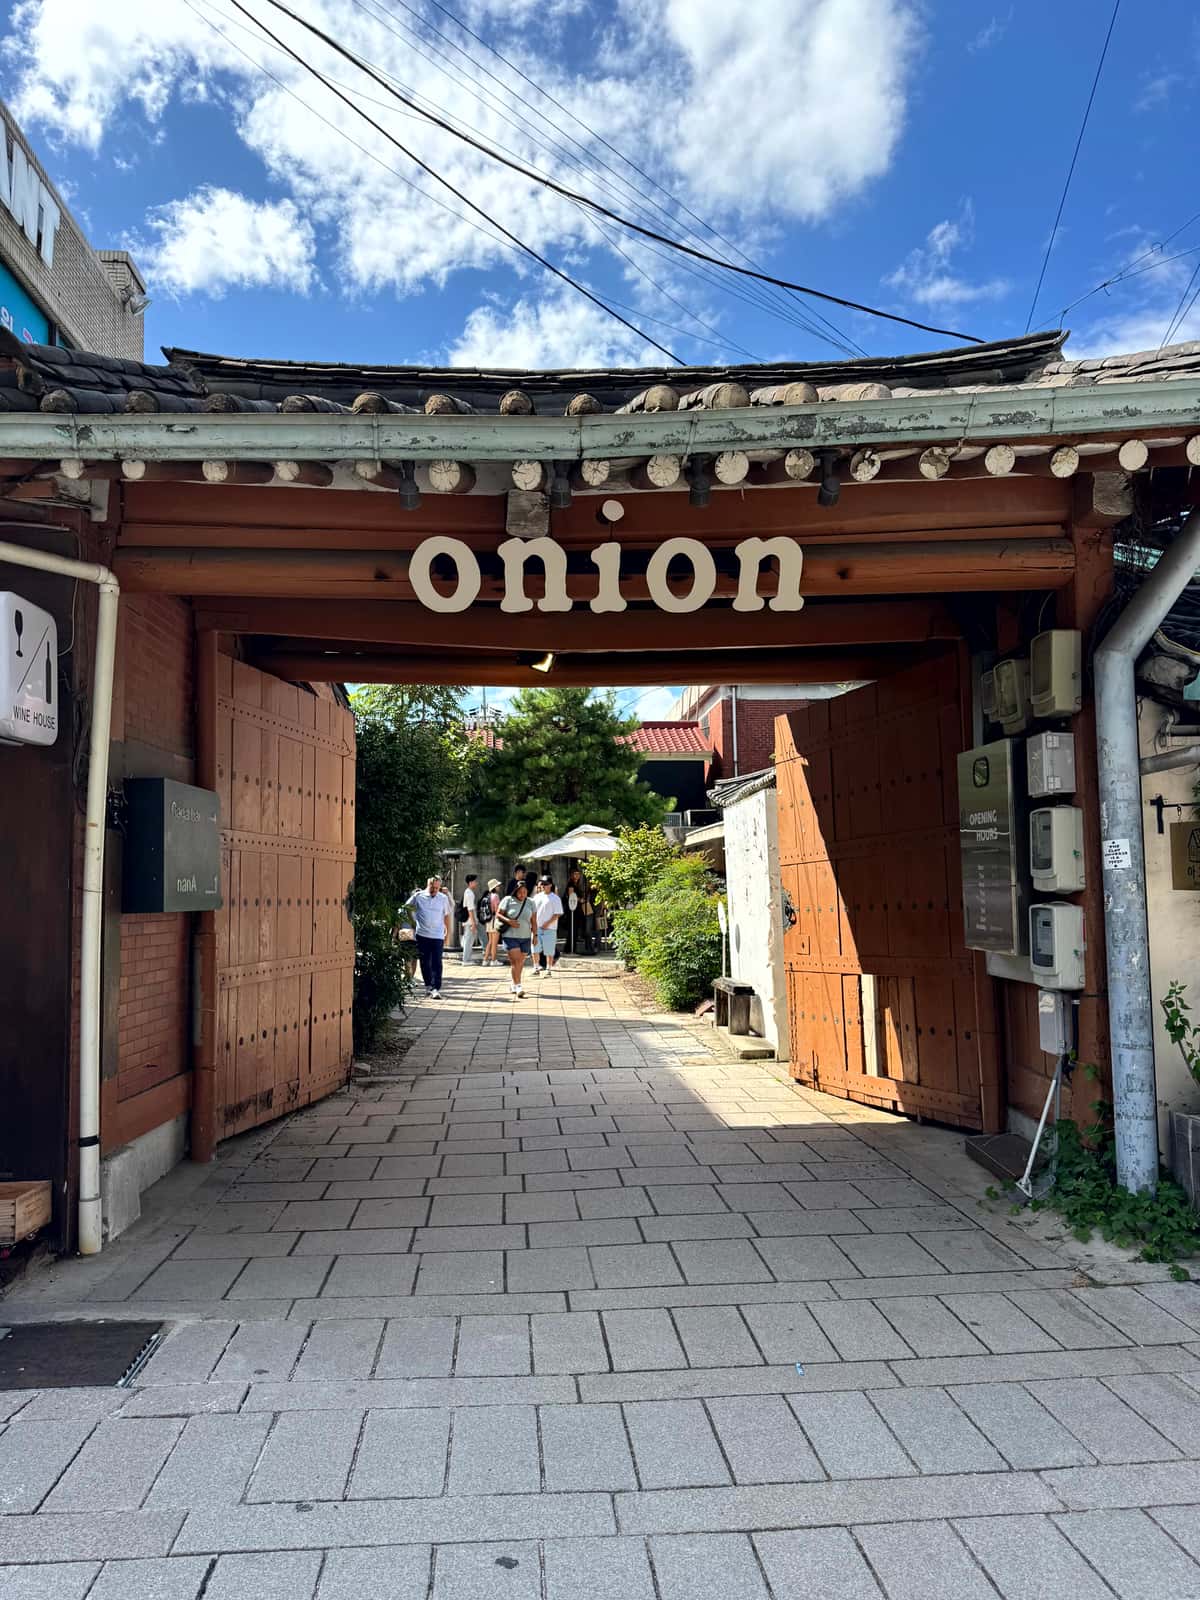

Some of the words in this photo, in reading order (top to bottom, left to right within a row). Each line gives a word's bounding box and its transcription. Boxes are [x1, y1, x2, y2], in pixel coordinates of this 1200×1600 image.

[408, 499, 805, 614] onion
[13, 705, 31, 723] WINE
[33, 711, 56, 730] HOUSE
[969, 808, 998, 826] OPENING
[976, 827, 999, 842] HOURS
[176, 873, 198, 893] nanA
